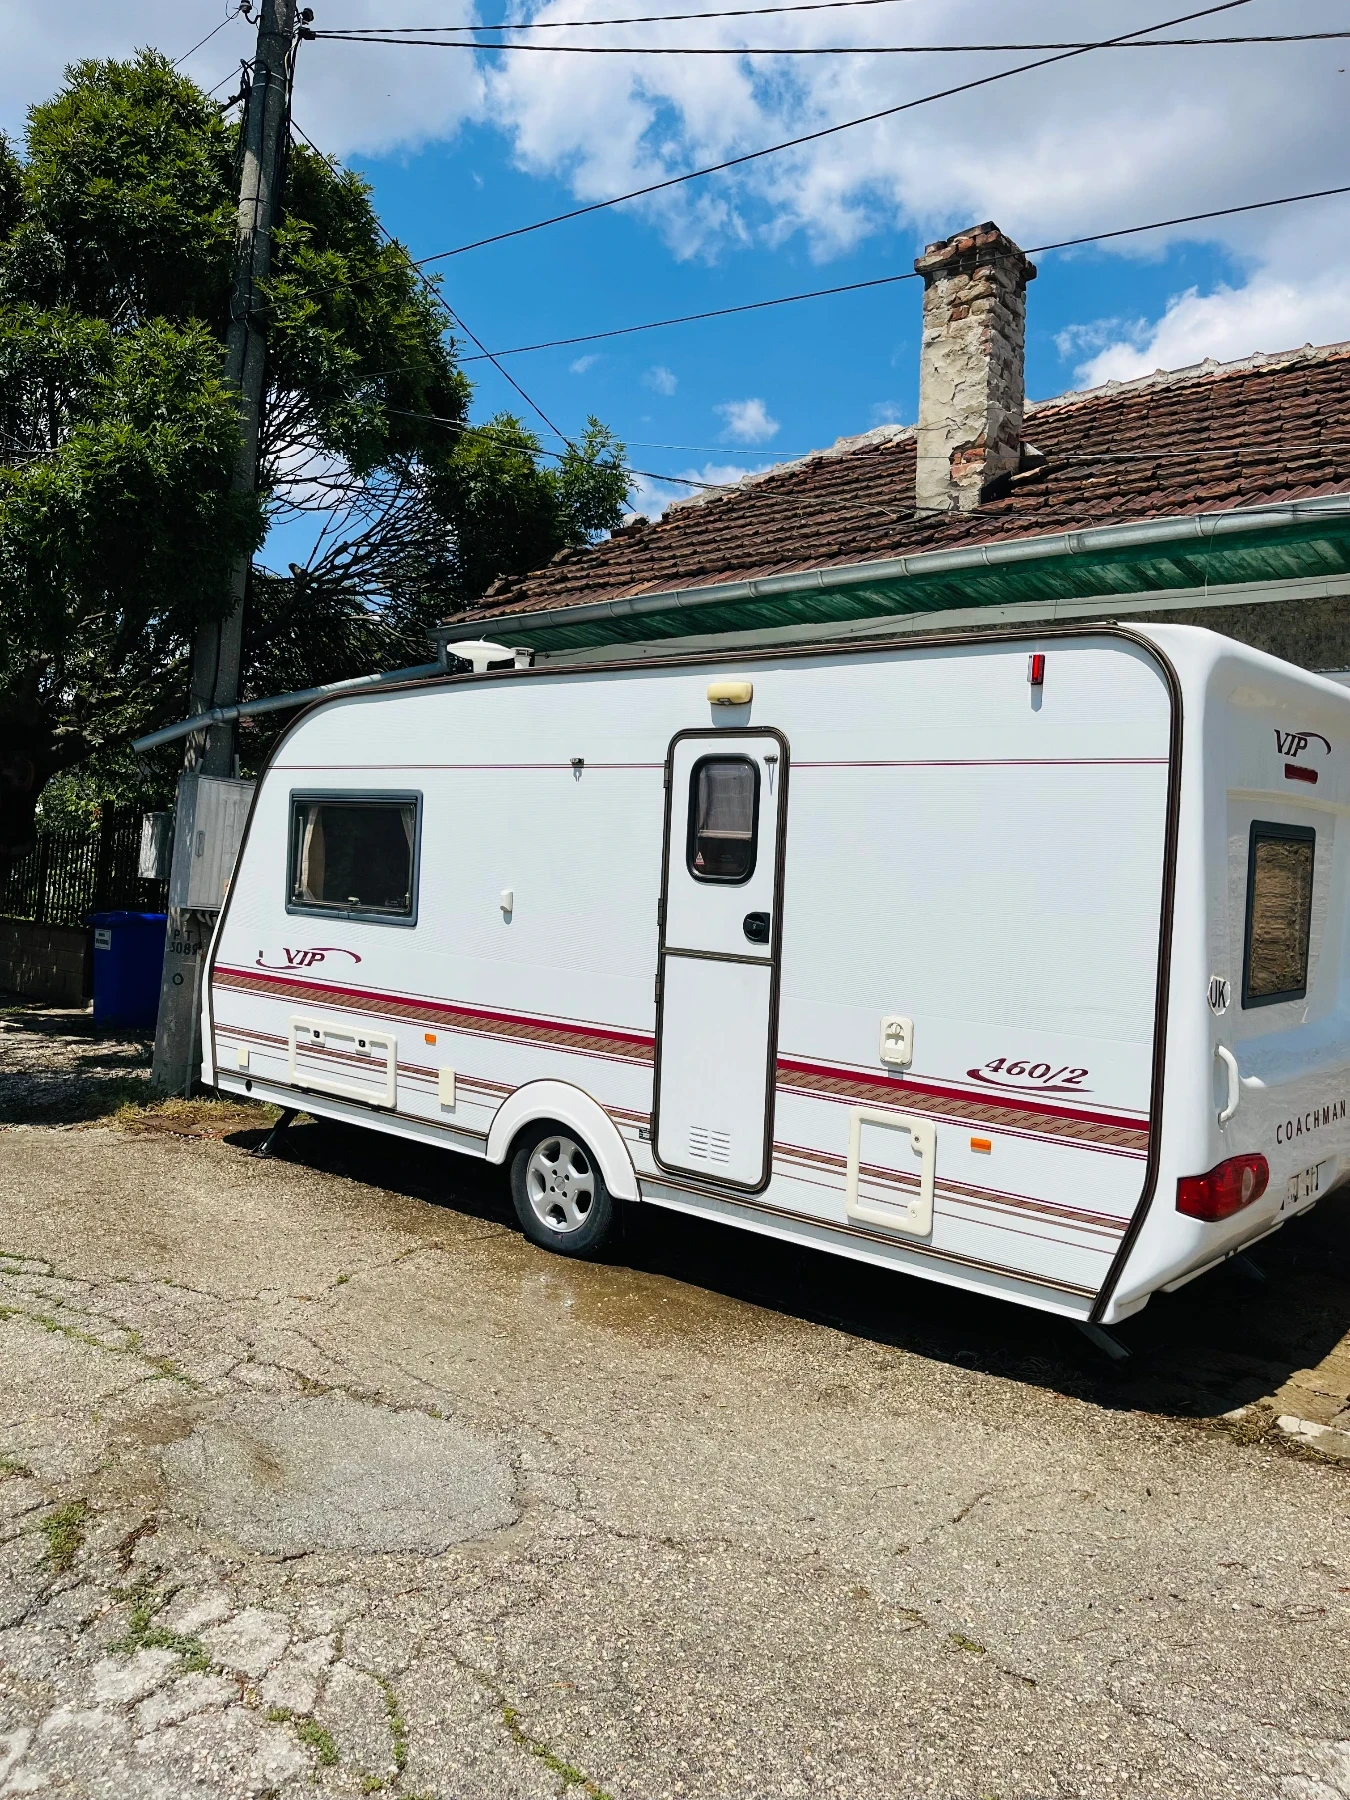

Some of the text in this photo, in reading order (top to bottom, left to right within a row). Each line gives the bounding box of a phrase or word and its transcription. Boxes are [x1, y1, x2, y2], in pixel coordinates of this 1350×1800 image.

[1273, 729, 1308, 757] VIP
[282, 947, 326, 967] VIP
[1210, 979, 1227, 1009] UK
[984, 1057, 1089, 1085] 460/2
[1276, 1099, 1346, 1145] COACHMAN
